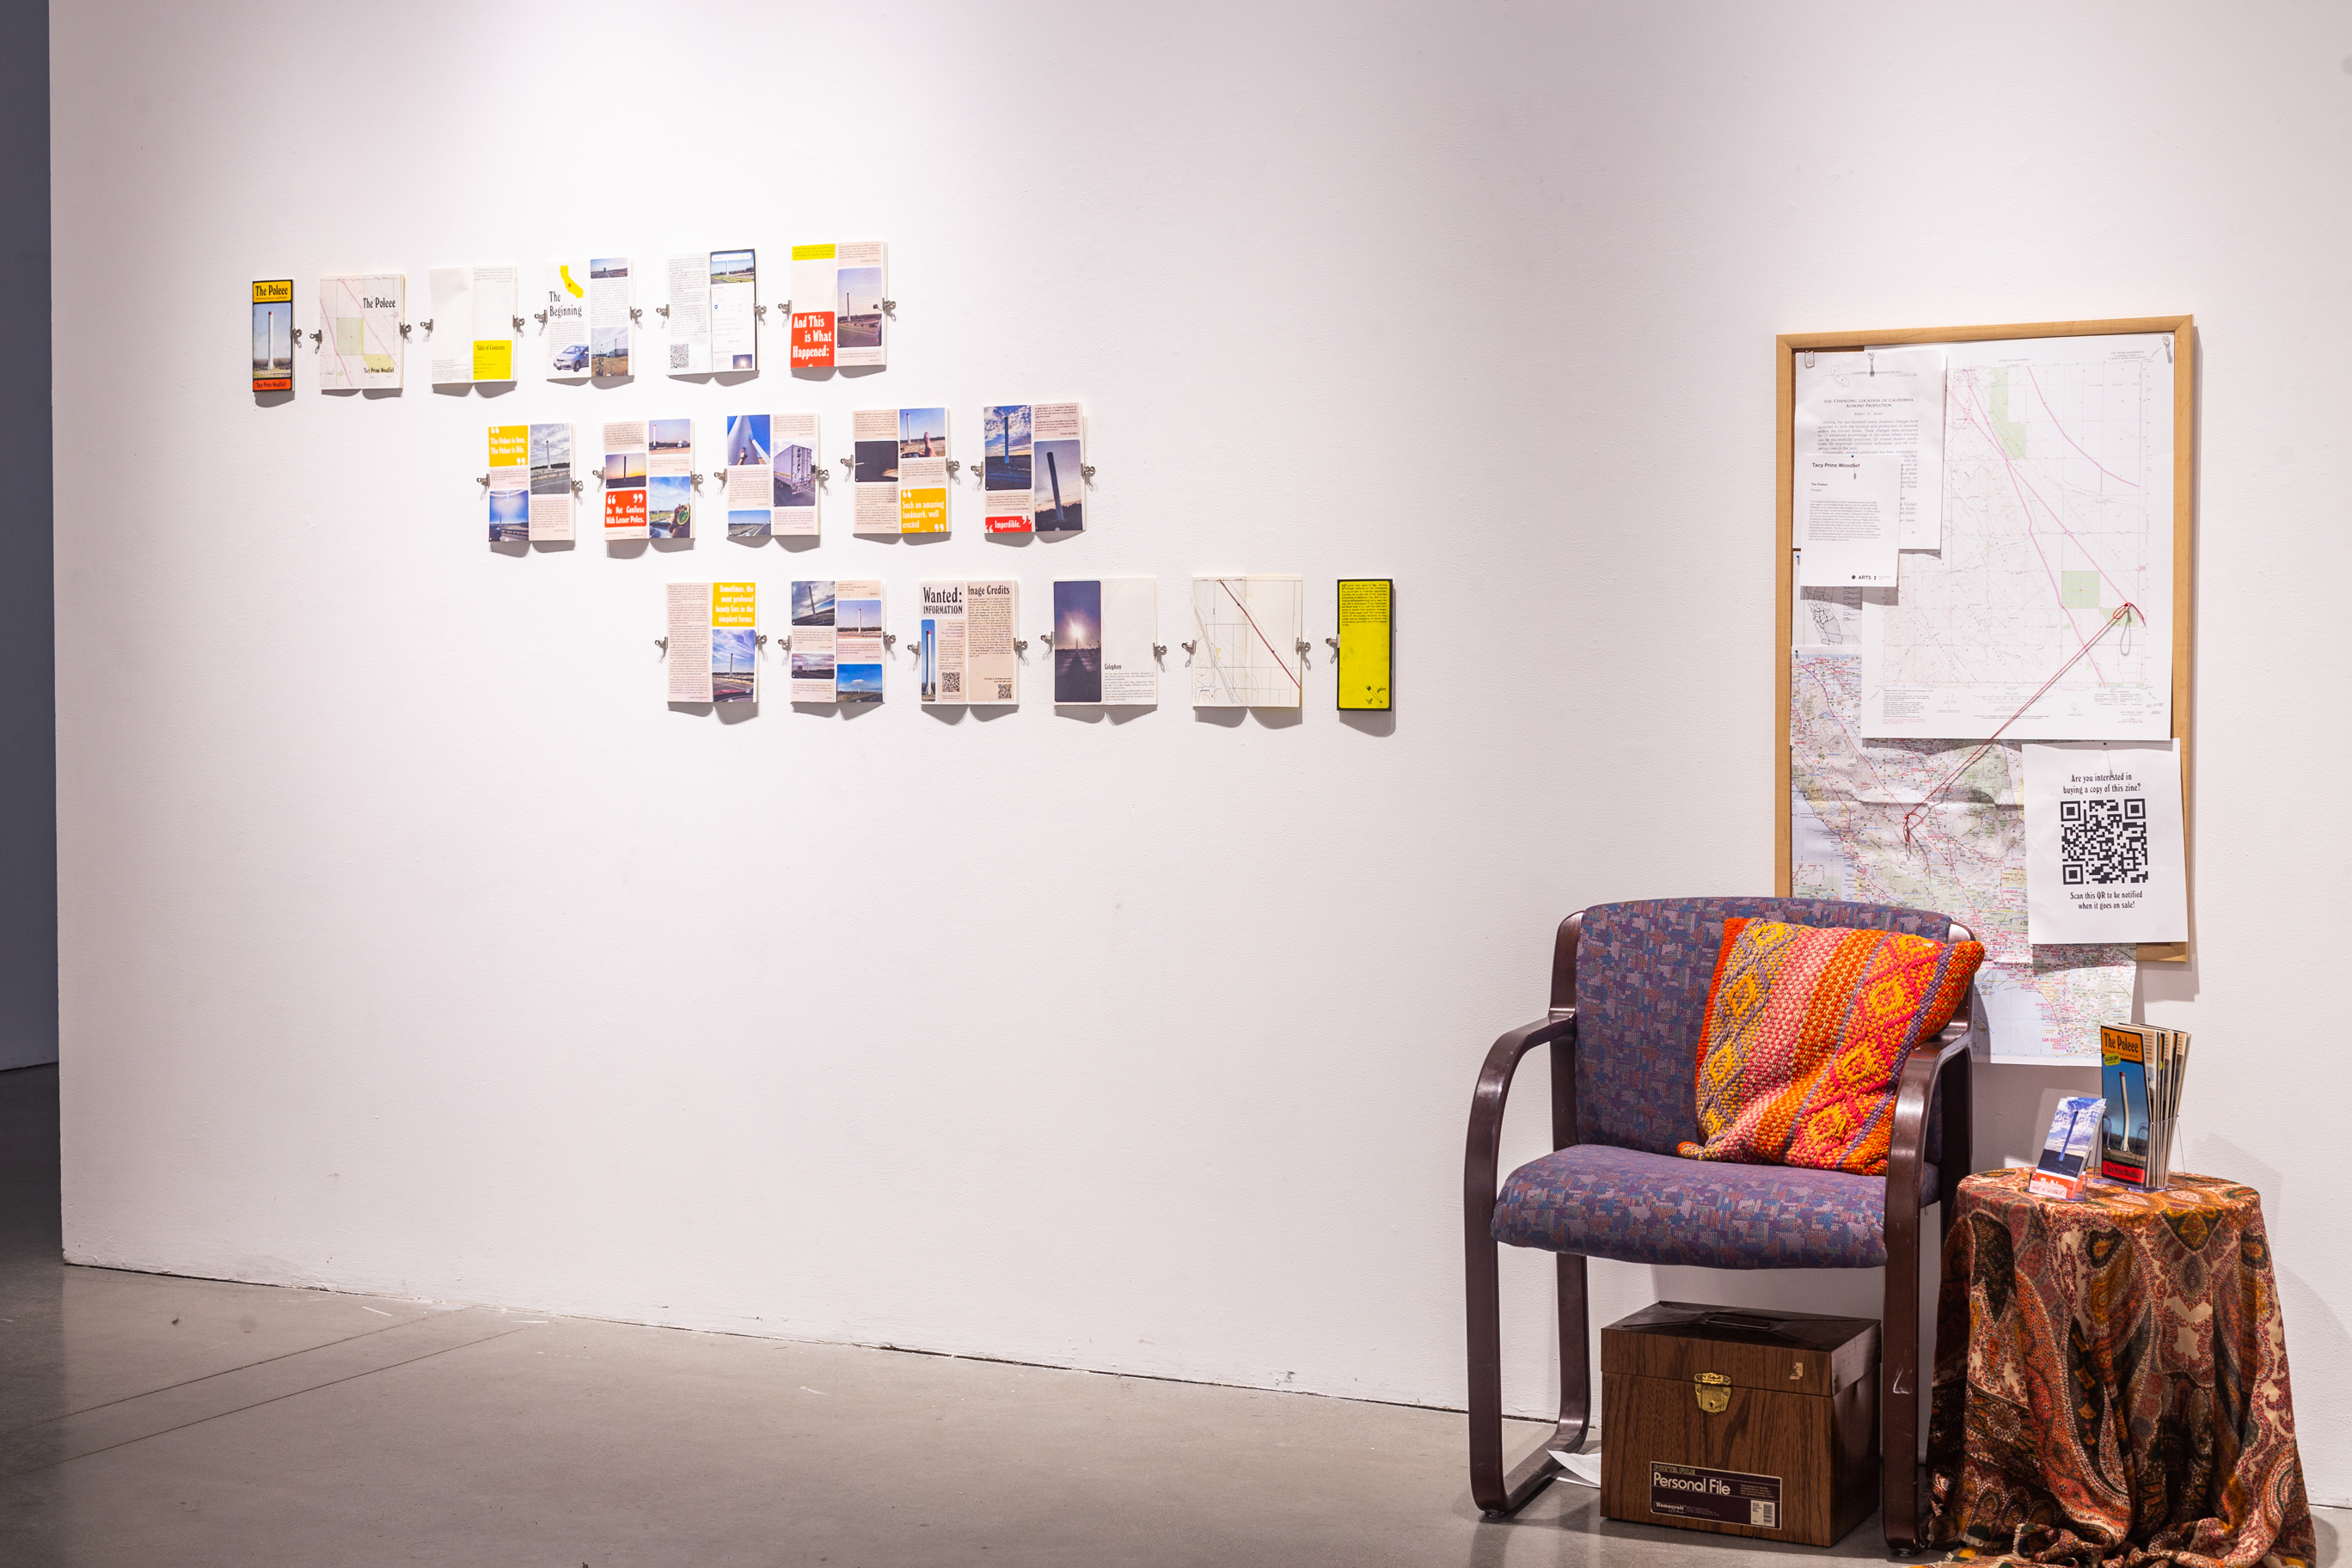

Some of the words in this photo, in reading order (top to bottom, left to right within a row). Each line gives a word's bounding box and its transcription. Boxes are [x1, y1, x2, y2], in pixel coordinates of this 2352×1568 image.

[255, 285, 266, 297] The
[269, 285, 288, 296] Poleee
[548, 291, 560, 302] The
[363, 297, 373, 309] The
[375, 297, 395, 308] Poleee
[550, 304, 582, 318] Beginning
[793, 316, 806, 328] And
[809, 315, 824, 328] This
[805, 331, 811, 342] is
[813, 330, 832, 341] What
[793, 345, 829, 359] Happened:
[903, 500, 914, 509] Such
[923, 500, 944, 509] amazing
[903, 510, 927, 518] landmark,
[903, 520, 919, 529] erected
[995, 520, 1020, 529] Imperdible.
[720, 585, 745, 593] Sometimes,
[968, 585, 985, 597] Image
[987, 585, 1010, 595] Credits
[733, 595, 754, 603] profound
[923, 587, 962, 603] Wanted:
[715, 605, 730, 614] beauty
[923, 605, 963, 614] INFORMATION
[719, 615, 738, 624] simplest
[2072, 774, 2081, 782] Are
[2095, 773, 2123, 781] interested
[2063, 786, 2083, 795] buying
[2125, 782, 2141, 792] zine?
[2104, 1032, 2115, 1049] The
[2117, 1035, 2138, 1053] Poleee
[1679, 1467, 1695, 1475] FILE
[1653, 1472, 1706, 1492] Personal
[1709, 1479, 1730, 1495] File
[1656, 1502, 1684, 1510] Homecraft
